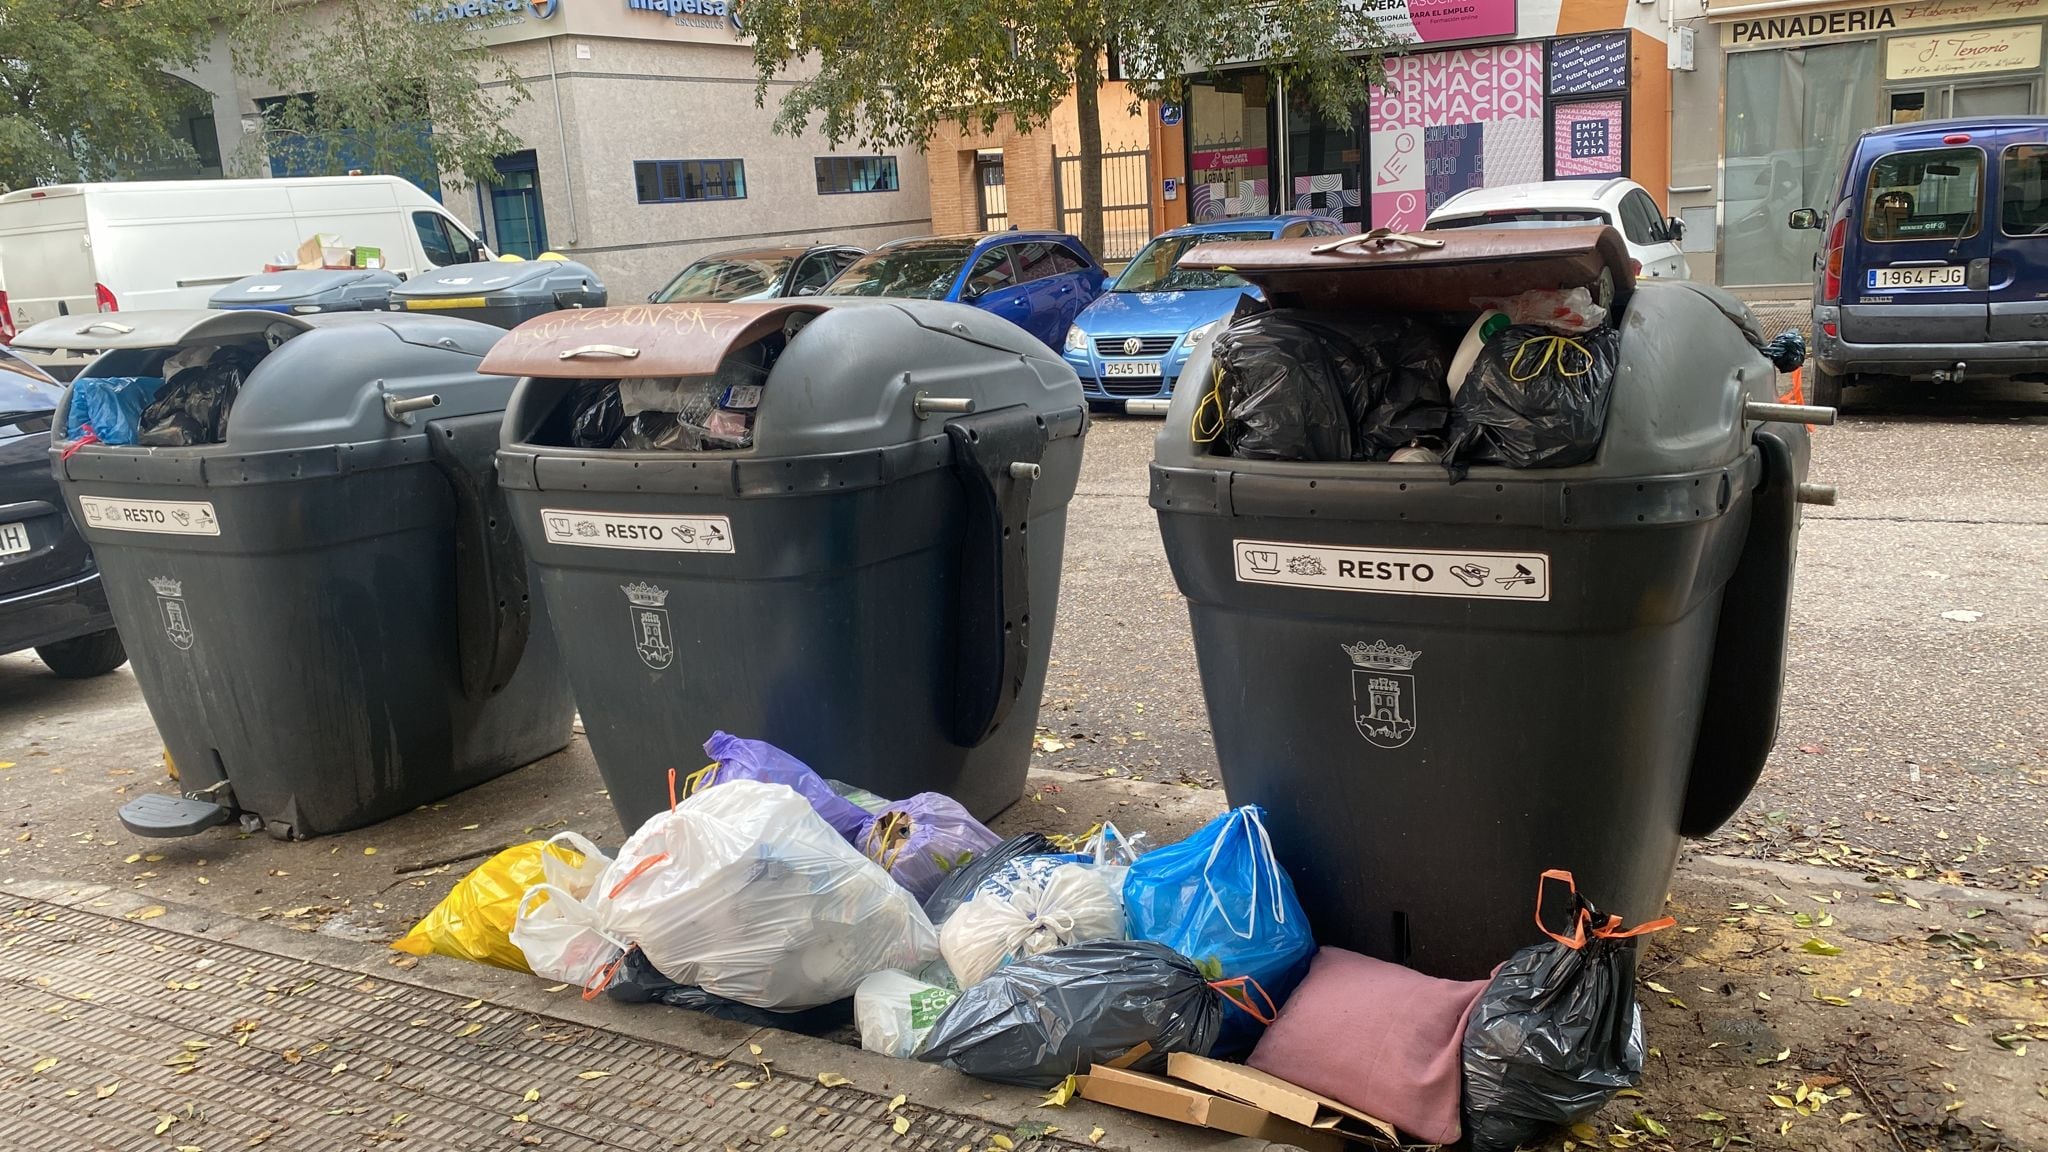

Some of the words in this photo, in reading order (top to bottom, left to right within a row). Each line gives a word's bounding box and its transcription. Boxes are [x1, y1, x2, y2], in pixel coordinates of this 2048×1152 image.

[1410, 9, 1430, 18] PARA
[1433, 8, 1442, 17] EL
[1443, 6, 1475, 16] EMPLEO
[1558, 45, 1580, 58] futuro
[1579, 43, 1602, 56] futuro
[1948, 33, 2009, 57] Tenorio
[1562, 57, 1584, 70] futuro
[1583, 54, 1606, 67] futuro
[1566, 68, 1588, 81] futuro
[1587, 66, 1610, 79] futuro
[1570, 80, 1592, 93] futuro
[1591, 78, 1614, 91] futuro
[1576, 122, 1604, 131] EMPL
[1576, 130, 1604, 139] EATE
[1576, 139, 1604, 147] TALA
[1576, 147, 1604, 156] VERA
[1882, 271, 1924, 285] 1964
[1929, 269, 1961, 283] FJG
[1107, 363, 1134, 375] 2545
[1137, 362, 1158, 374] DTV
[123, 508, 165, 524] RESTO
[605, 523, 663, 540] RESTO
[1339, 559, 1434, 582] RESTO
